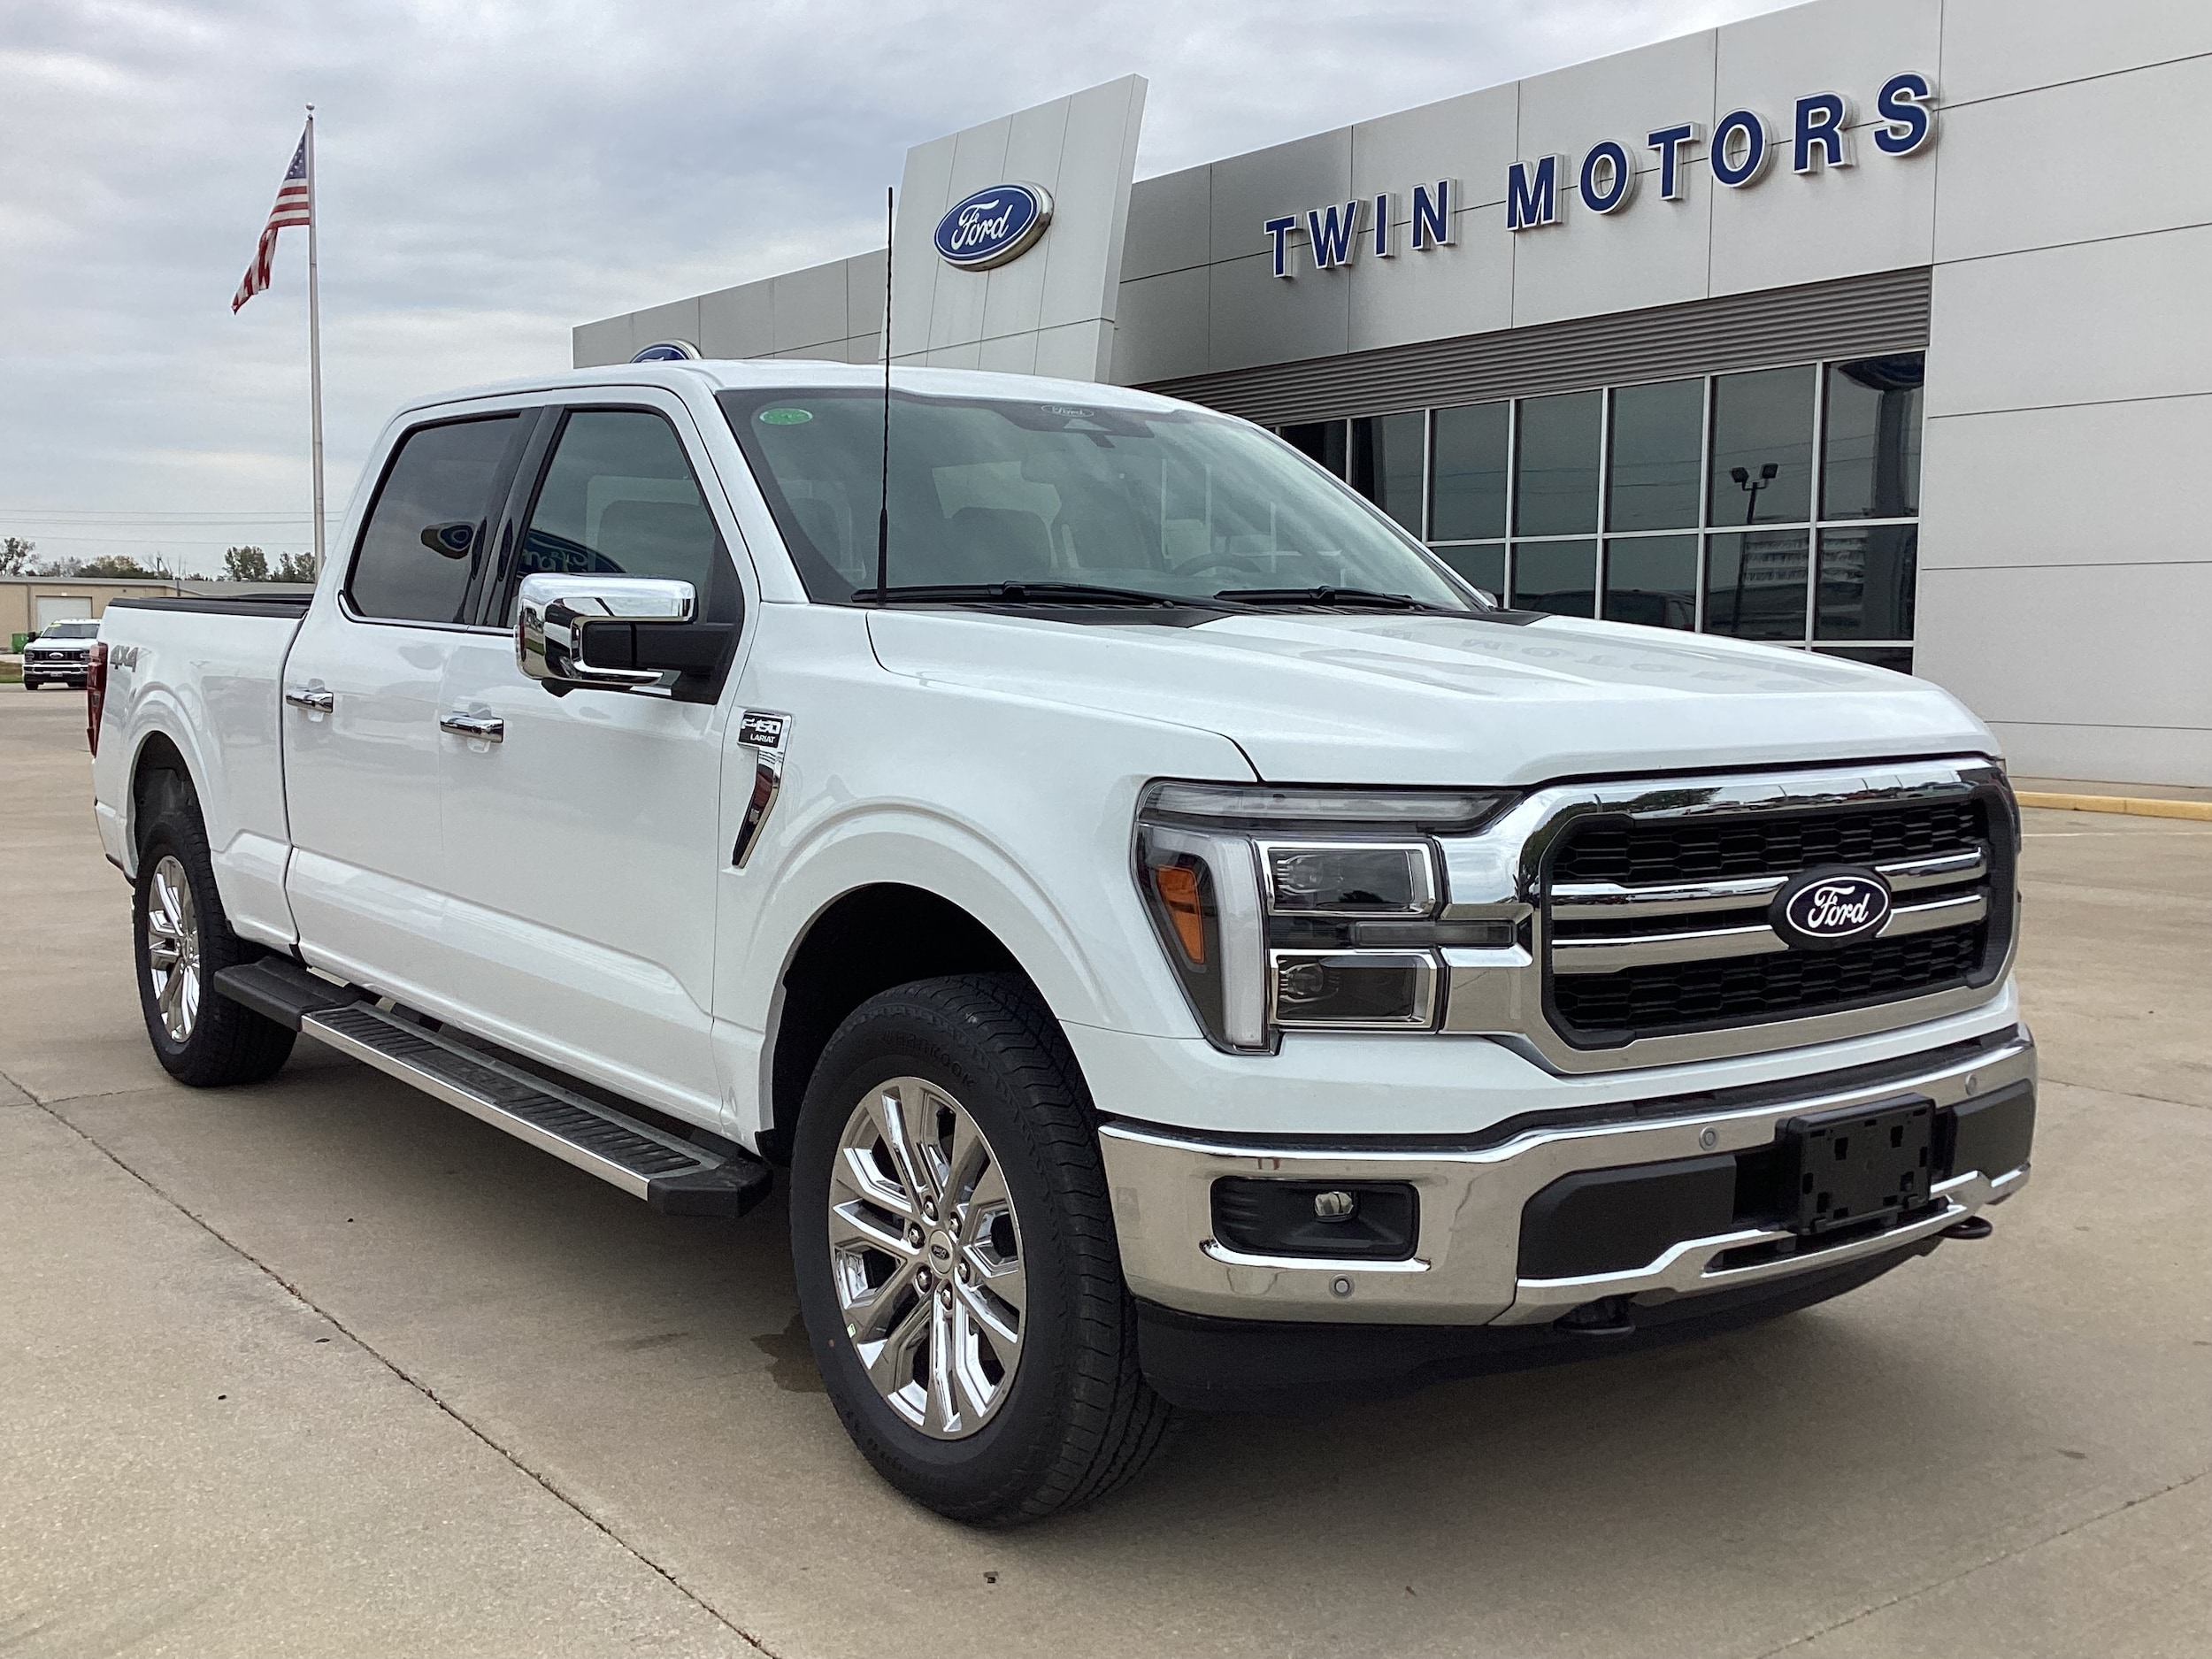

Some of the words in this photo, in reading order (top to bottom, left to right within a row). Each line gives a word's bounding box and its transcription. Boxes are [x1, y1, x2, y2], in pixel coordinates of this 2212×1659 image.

[1263, 179, 1456, 279] TWIN
[1506, 71, 1938, 231] MOTORS
[951, 199, 1013, 250] Ford
[750, 733, 775, 743] LARIAT
[1808, 886, 1870, 928] Ford
